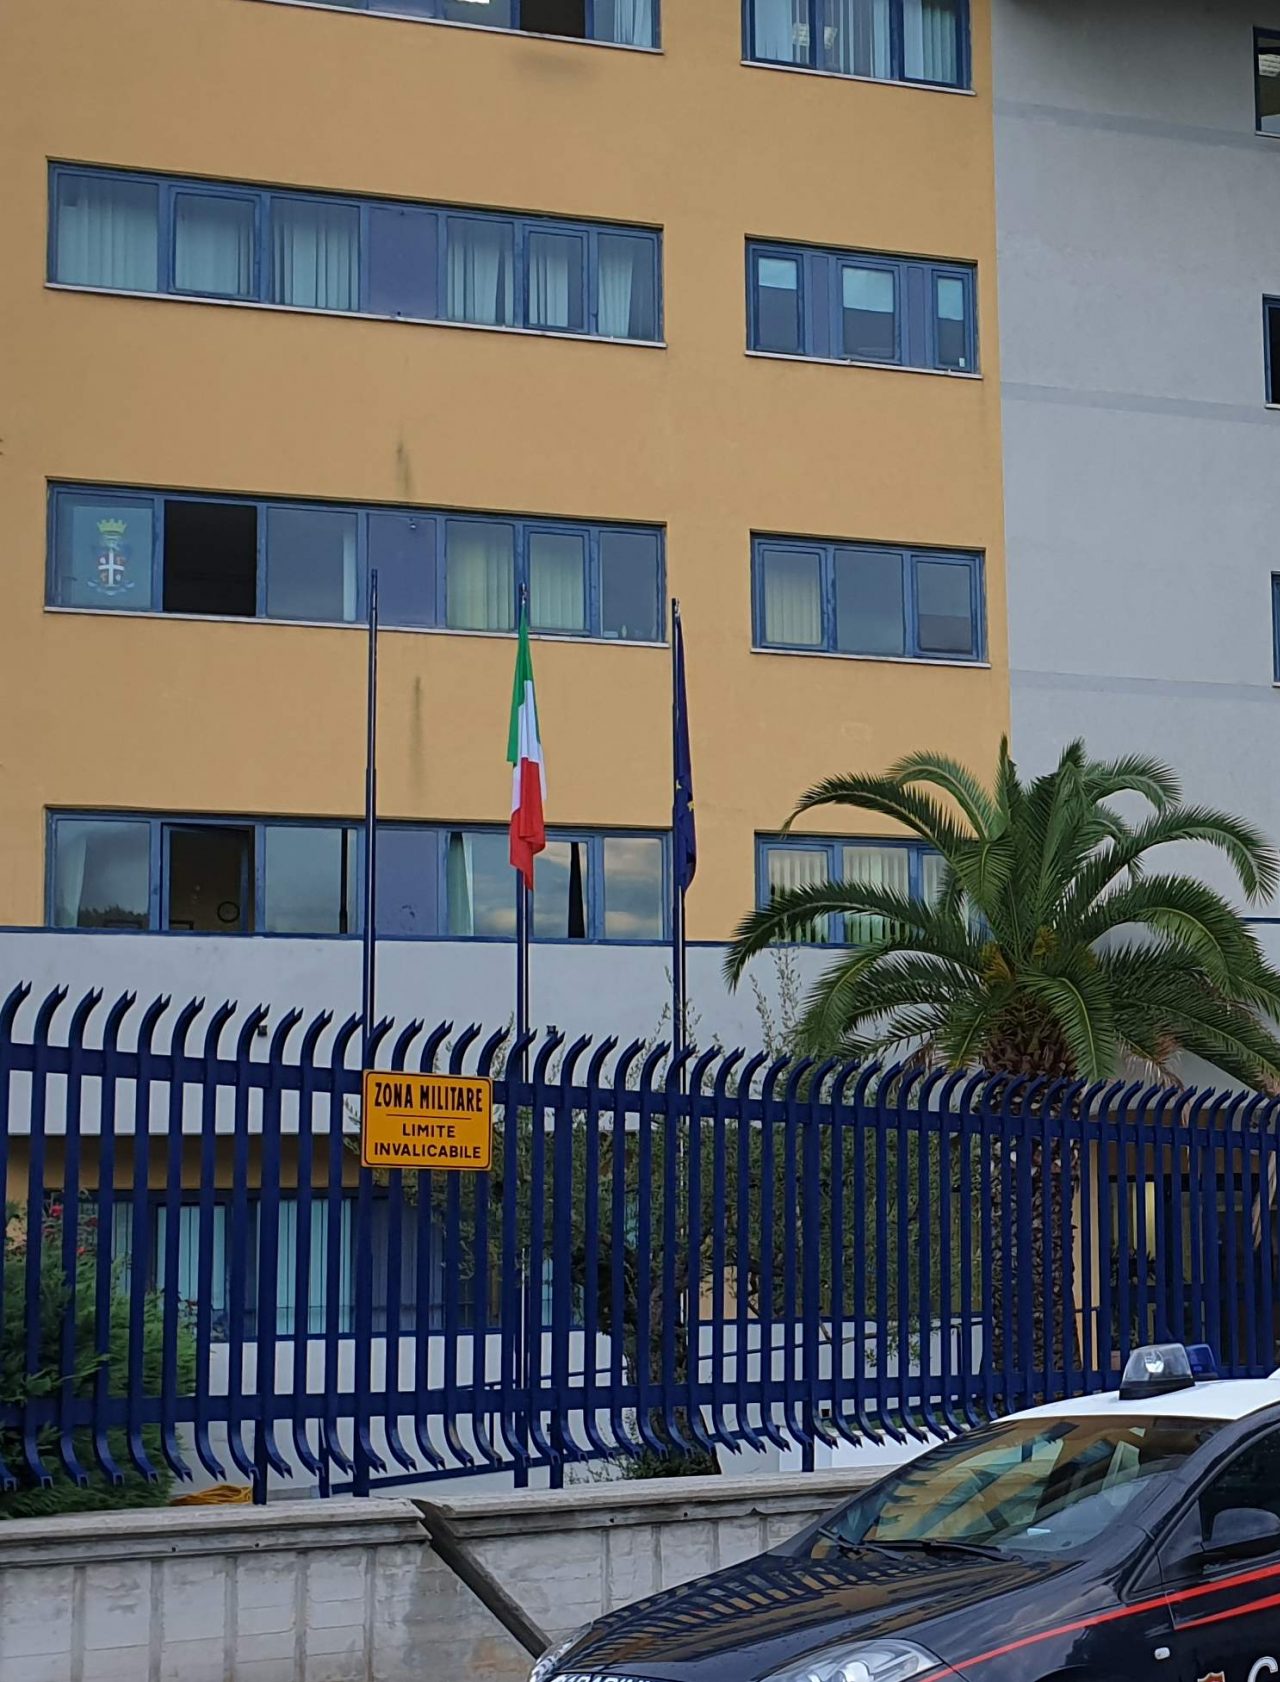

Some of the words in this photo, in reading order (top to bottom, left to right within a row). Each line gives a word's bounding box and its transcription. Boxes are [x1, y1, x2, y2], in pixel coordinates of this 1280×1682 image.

[374, 1081, 413, 1109] ZONA
[419, 1085, 483, 1112] MILITARE
[402, 1123, 456, 1138] LIMITE
[374, 1142, 481, 1159] INVALICABILE
